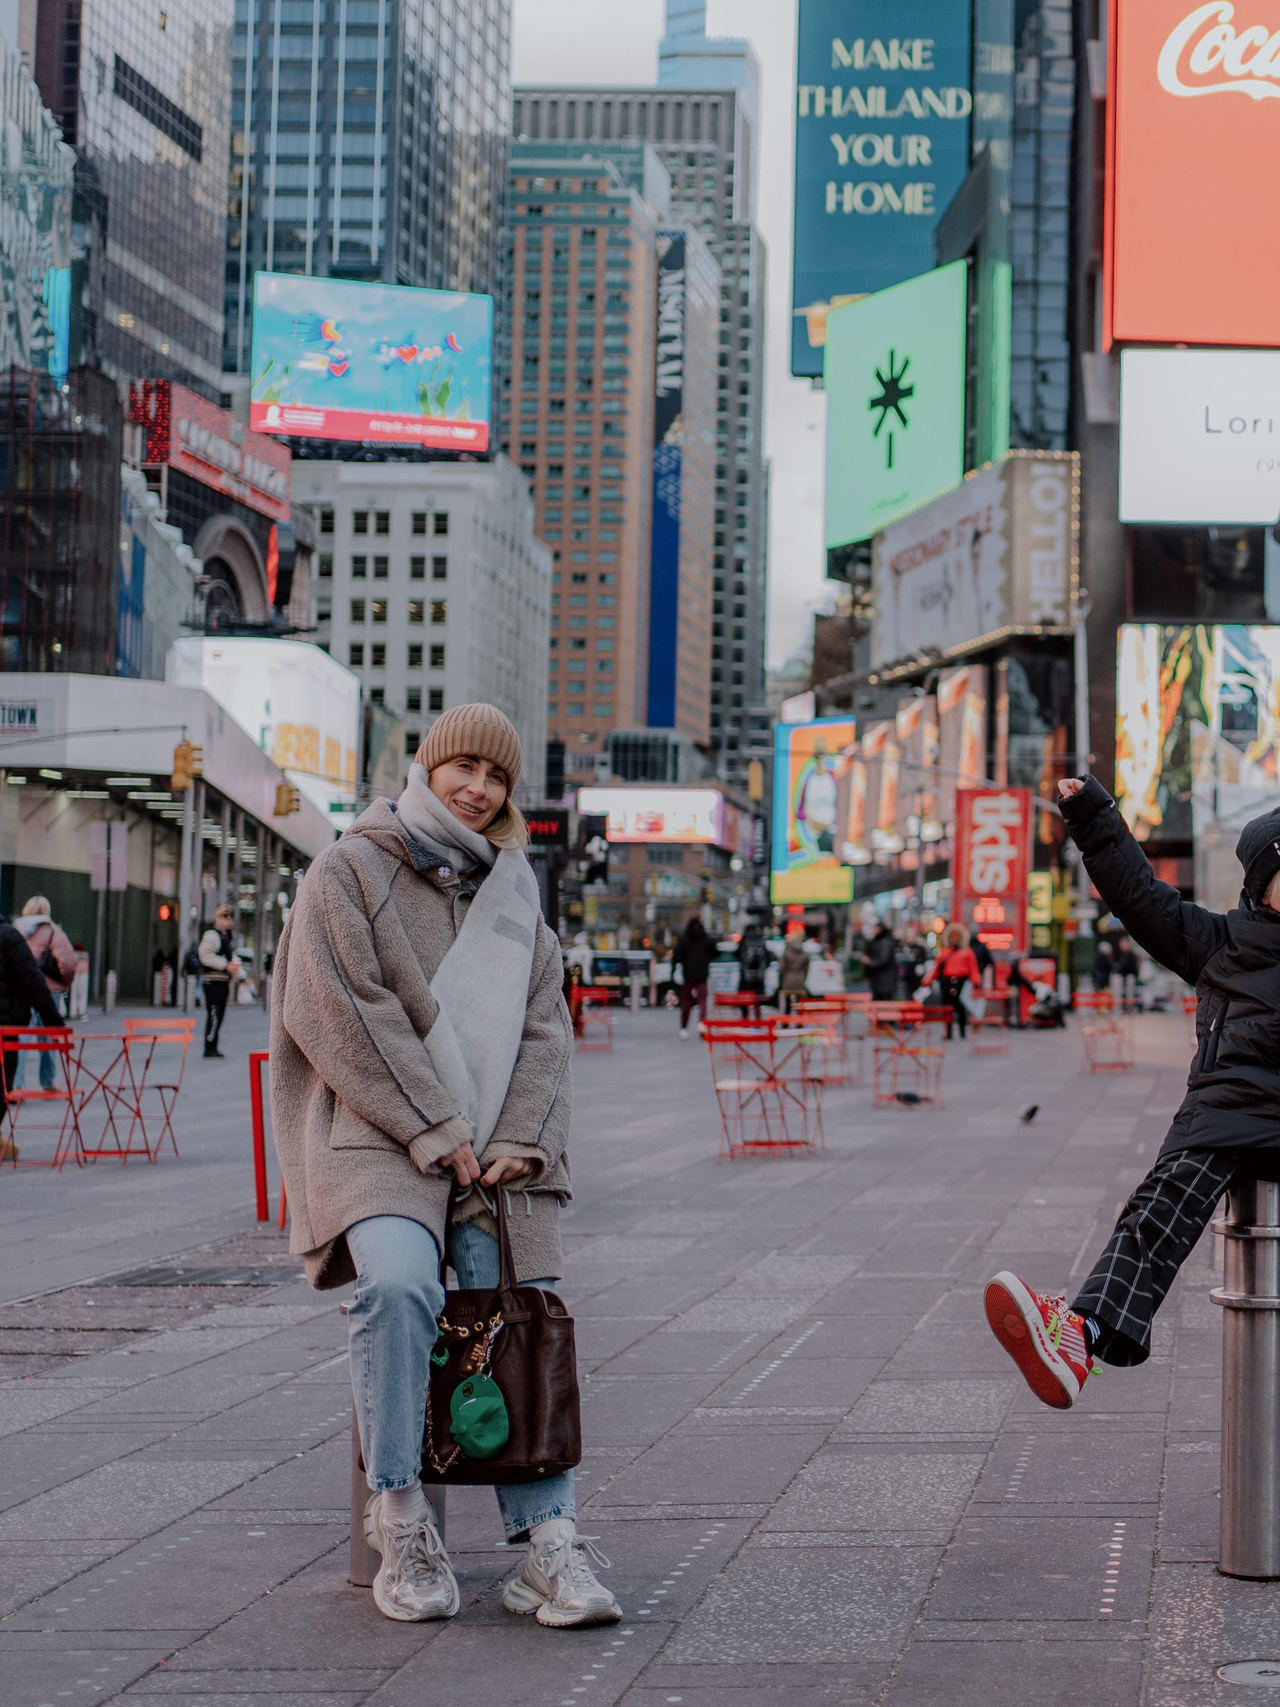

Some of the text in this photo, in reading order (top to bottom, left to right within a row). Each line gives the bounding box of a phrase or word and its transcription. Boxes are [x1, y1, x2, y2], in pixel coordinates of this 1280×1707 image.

[831, 38, 935, 70] MAKE
[798, 85, 971, 118] THAILAND
[830, 133, 932, 166] YOUR
[826, 181, 936, 214] HOME
[1204, 405, 1273, 435] Lori
[1032, 463, 1067, 622] HELLO!
[969, 793, 1022, 894] tkts
